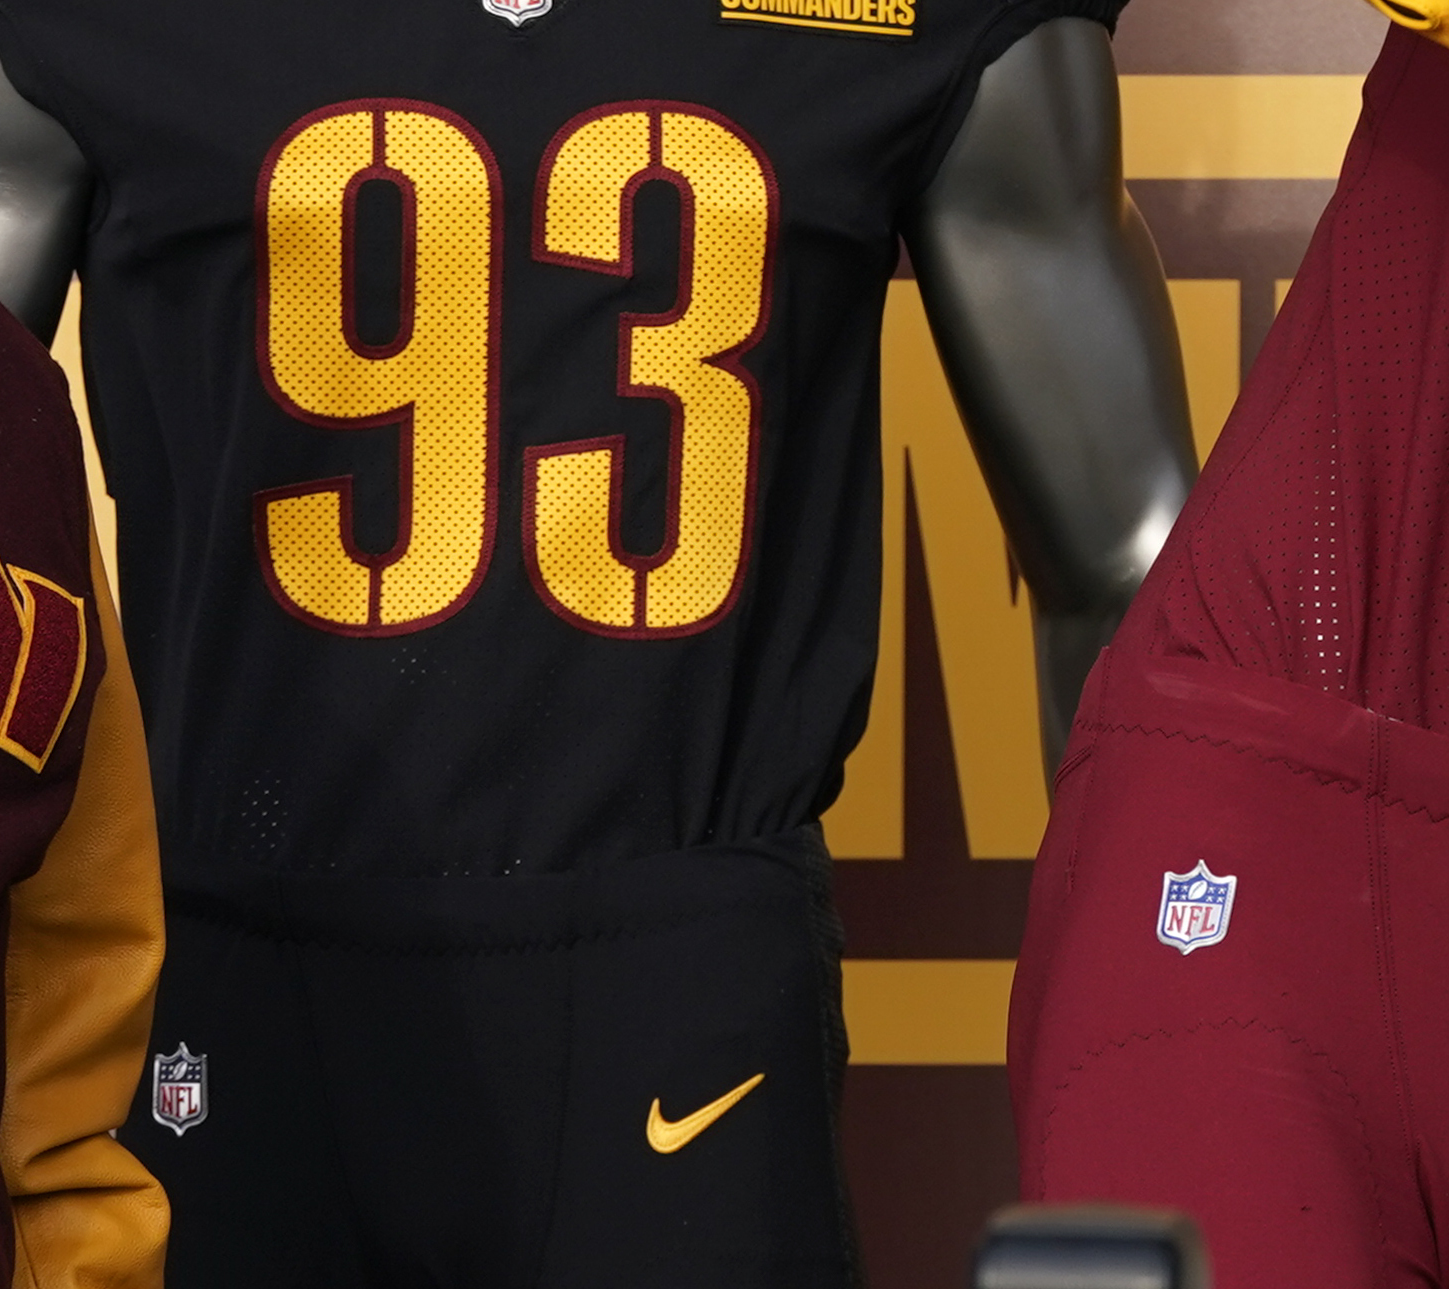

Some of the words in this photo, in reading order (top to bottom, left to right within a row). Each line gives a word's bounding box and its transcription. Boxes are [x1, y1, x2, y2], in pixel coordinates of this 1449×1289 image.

[255, 96, 780, 640] 93
[1167, 905, 1216, 936] NFL
[160, 1086, 198, 1119] NFL
